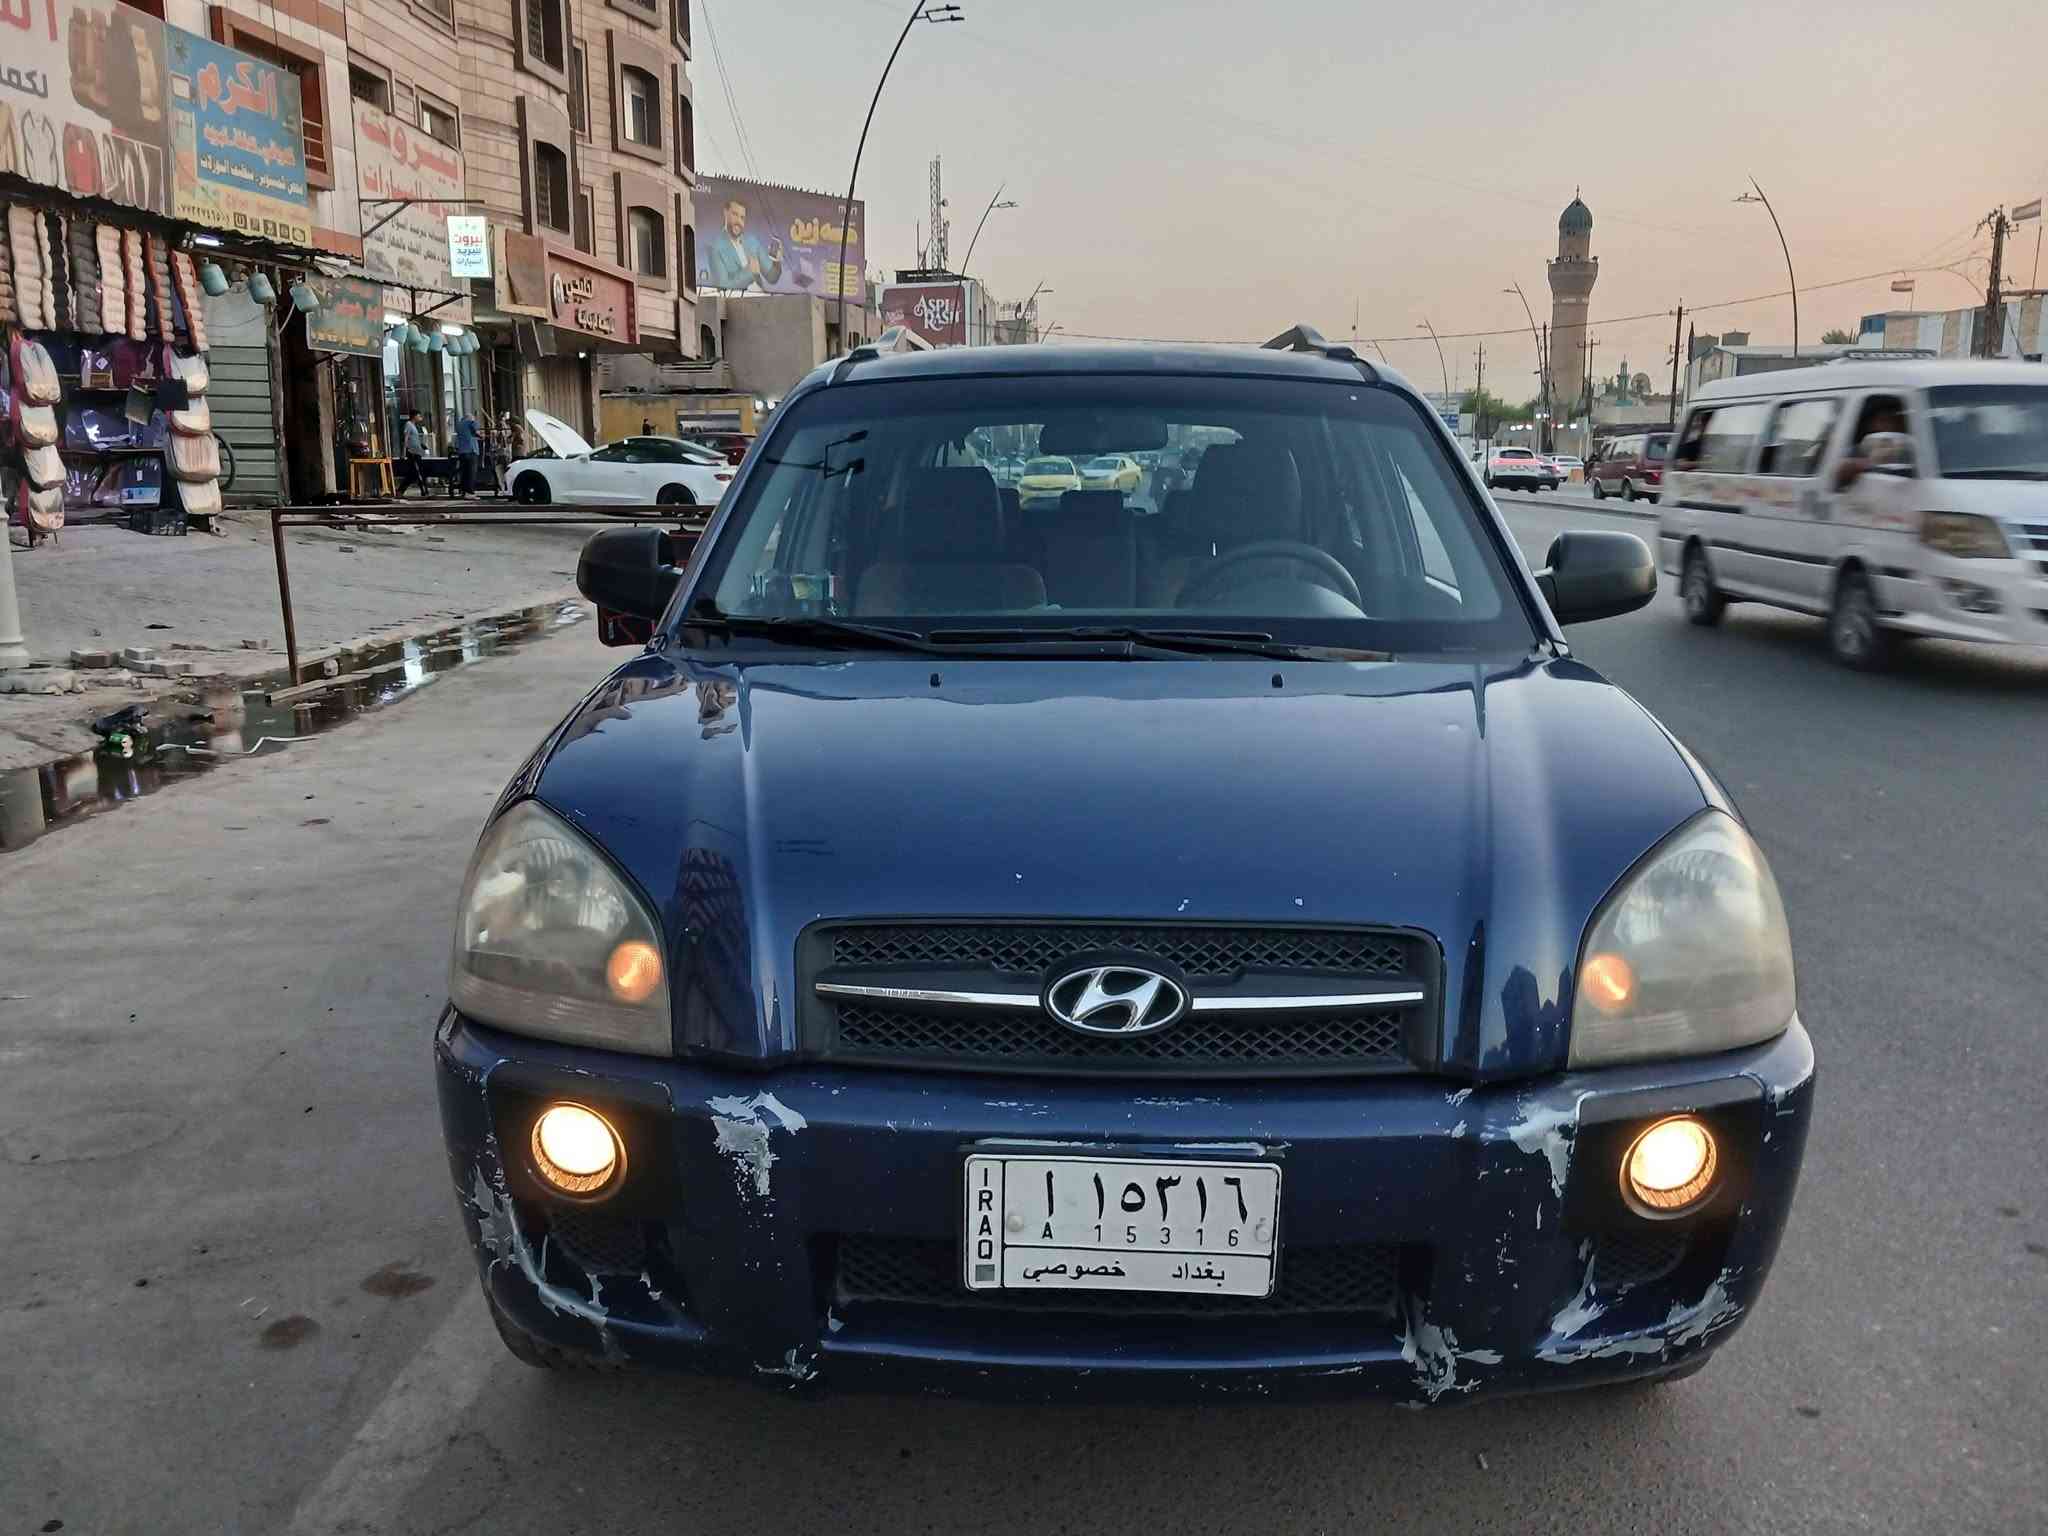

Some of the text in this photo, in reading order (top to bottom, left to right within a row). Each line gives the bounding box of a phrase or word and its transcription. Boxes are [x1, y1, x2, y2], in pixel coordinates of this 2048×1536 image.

[197, 62, 277, 119] الكرم
[977, 1168, 993, 1260] IRAQ
[1042, 1222, 1053, 1240] A
[1023, 1260, 1226, 1287] بغداد خصوصي
